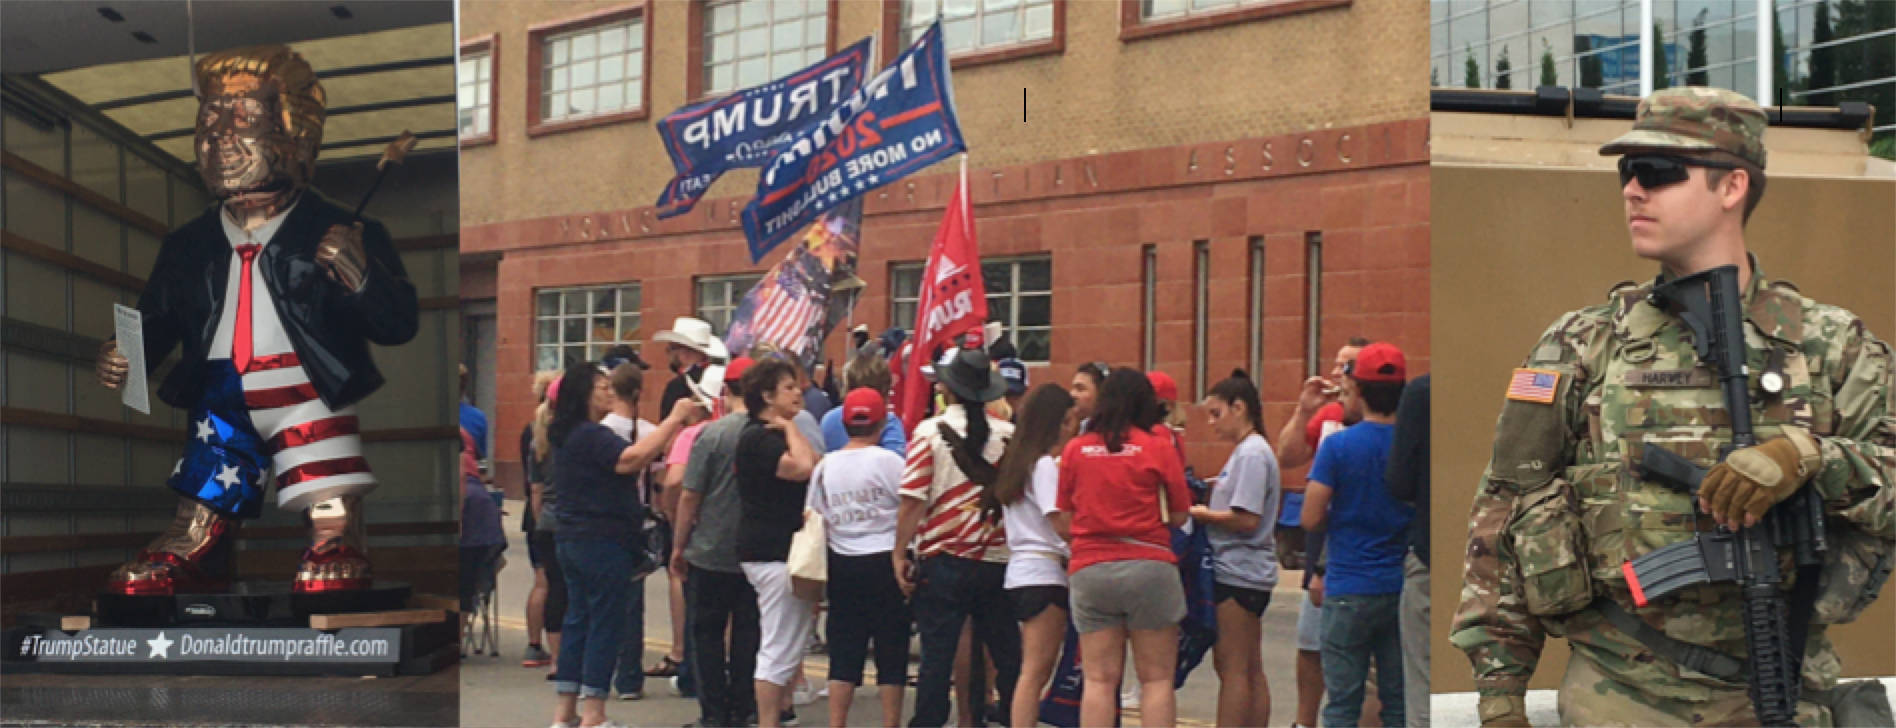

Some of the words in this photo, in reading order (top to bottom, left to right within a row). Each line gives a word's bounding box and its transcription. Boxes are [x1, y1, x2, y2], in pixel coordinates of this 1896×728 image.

[1643, 372, 1692, 385] HARVEY
[20, 633, 137, 660] #TrumpStatue
[180, 633, 389, 660] Donaldtrumpraffle.com
